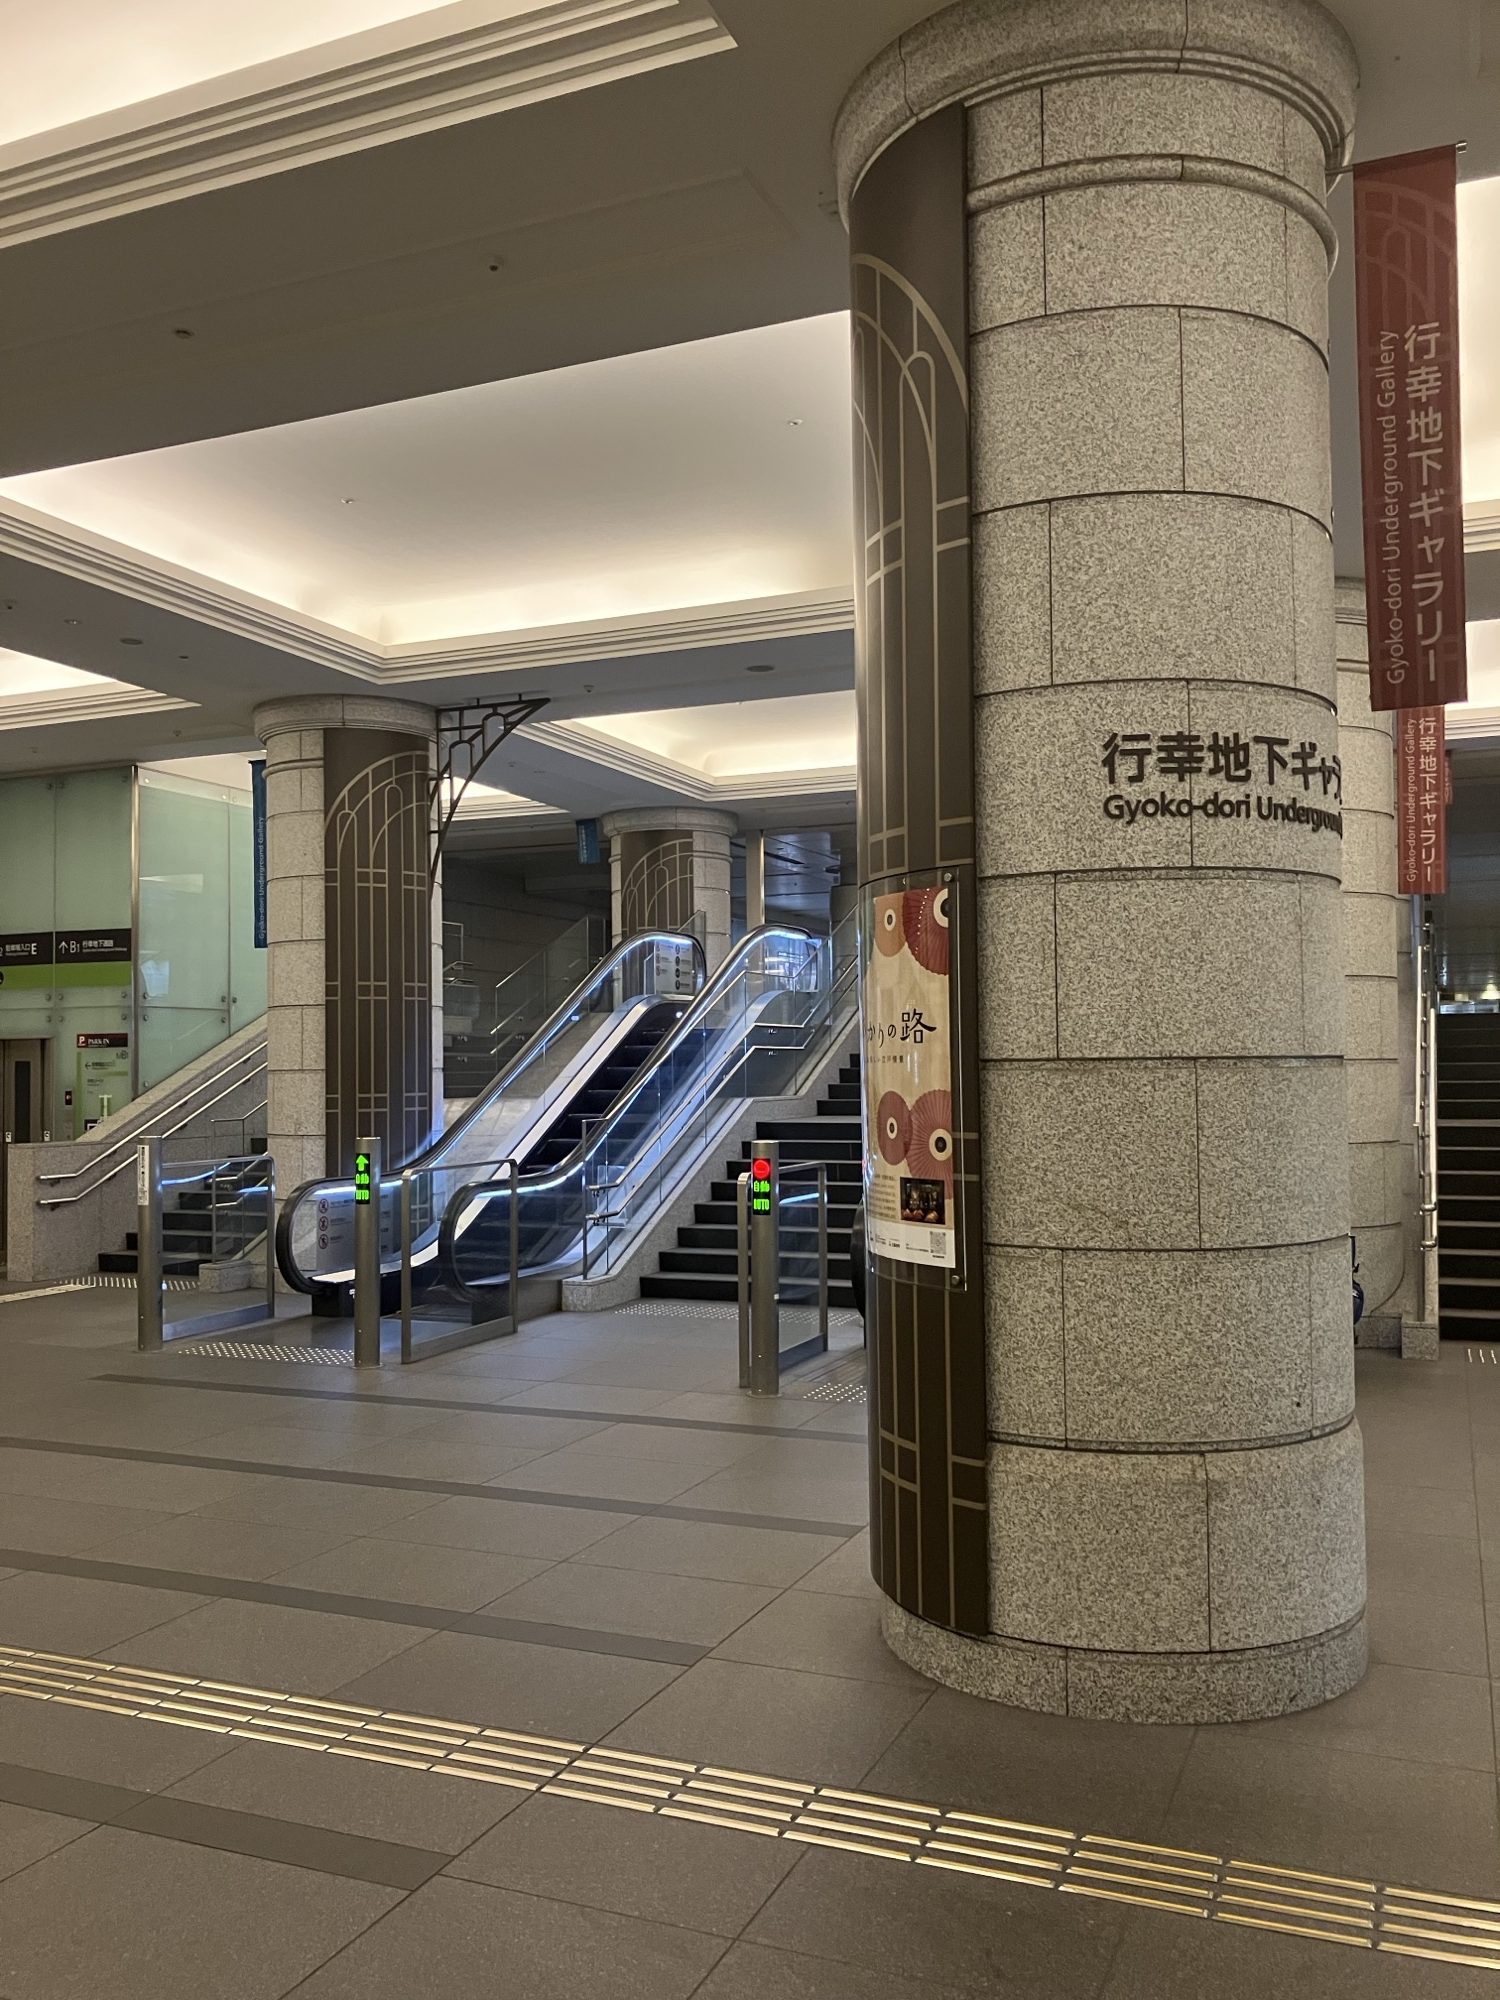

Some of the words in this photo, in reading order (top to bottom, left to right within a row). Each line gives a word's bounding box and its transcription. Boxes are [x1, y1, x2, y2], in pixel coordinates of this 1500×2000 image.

[1375, 330, 1400, 408] Gallery
[1377, 415, 1404, 561] Underground
[1404, 321, 1446, 682] 行幸地下ギャラリー
[1382, 568, 1410, 684] Gyoko-dori
[1404, 719, 1417, 754] Gallery
[1103, 791, 1251, 825] Gyoko-dori
[1404, 755, 1418, 823] Underground
[1419, 717, 1438, 882] 行幸地下ギャラリー
[1406, 824, 1418, 882] Gyoko-dori
[31, 943, 37, 955] E
[865, 1008, 937, 1049] かりの路
